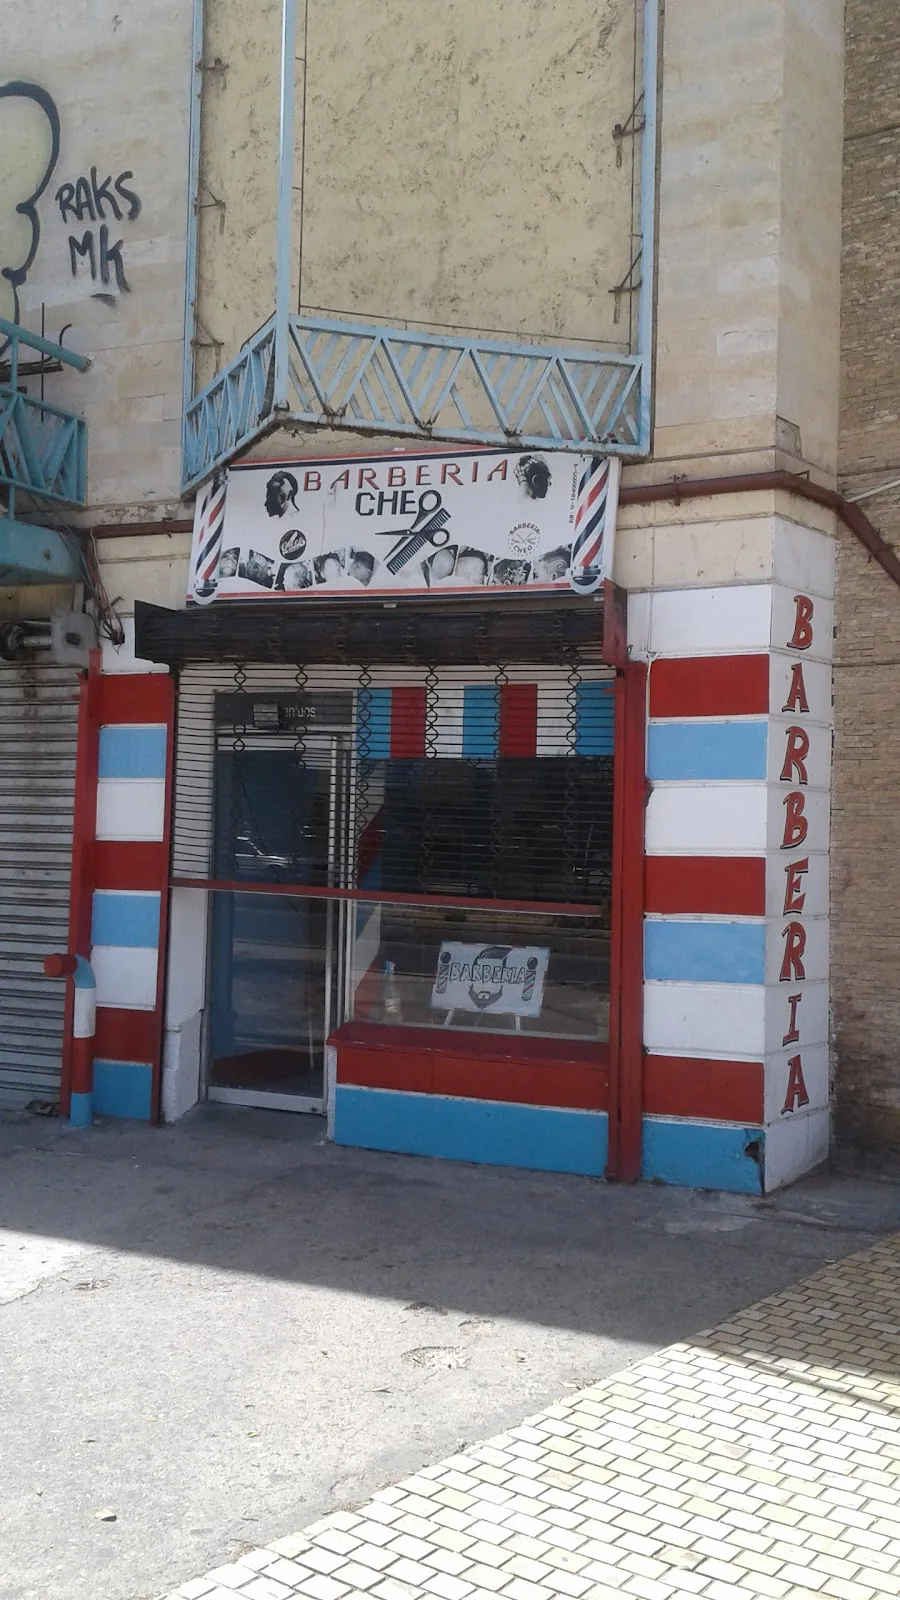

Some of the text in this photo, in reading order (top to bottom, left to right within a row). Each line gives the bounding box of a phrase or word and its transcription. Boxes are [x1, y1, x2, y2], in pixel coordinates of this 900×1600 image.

[55, 165, 142, 223] RAKS
[303, 459, 508, 491] BARBERIA
[509, 522, 541, 536] BARBERIA
[513, 545, 533, 554] CHEO
[780, 594, 814, 1115] BARBERIA
[449, 962, 526, 985] BARBERIA
